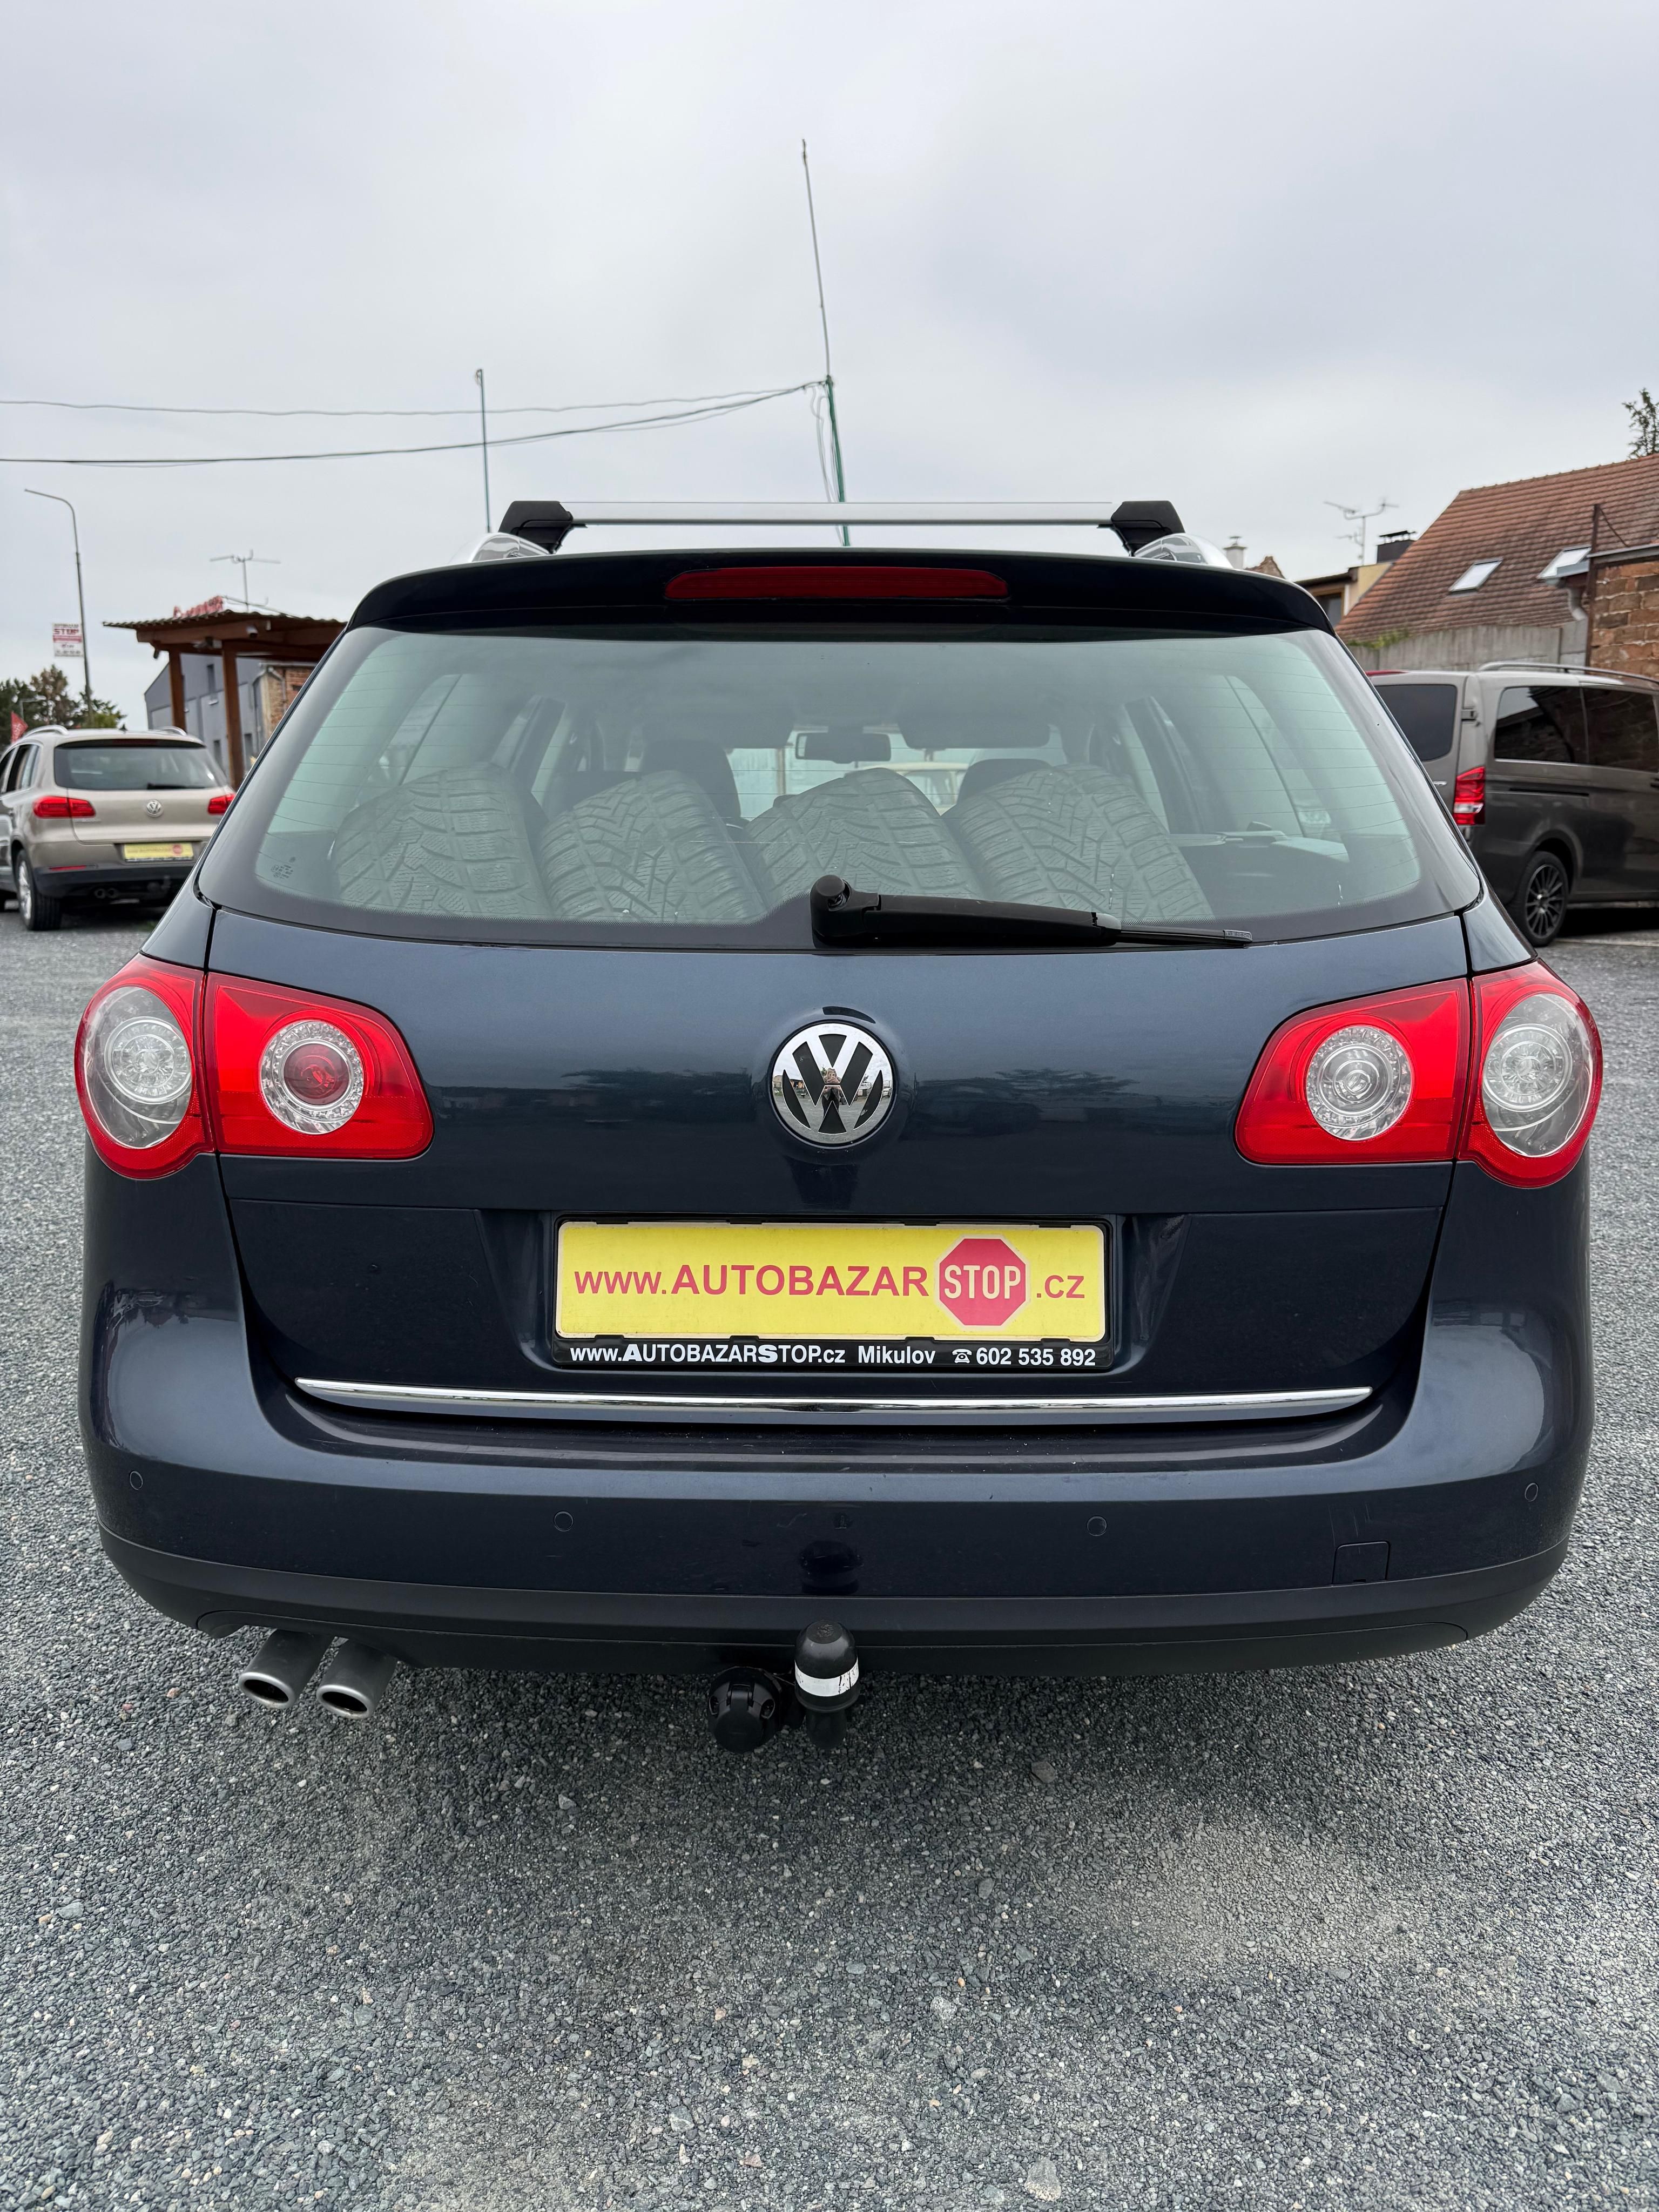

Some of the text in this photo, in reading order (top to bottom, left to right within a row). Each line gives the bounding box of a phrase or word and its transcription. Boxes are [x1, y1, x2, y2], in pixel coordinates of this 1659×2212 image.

[574, 1264, 929, 1297] www.AUTOBAZAR
[944, 1264, 1021, 1299] STOP
[570, 1344, 1096, 1366] www.AUTOBAZARSTOP.cz Mikulov 602 535 892
